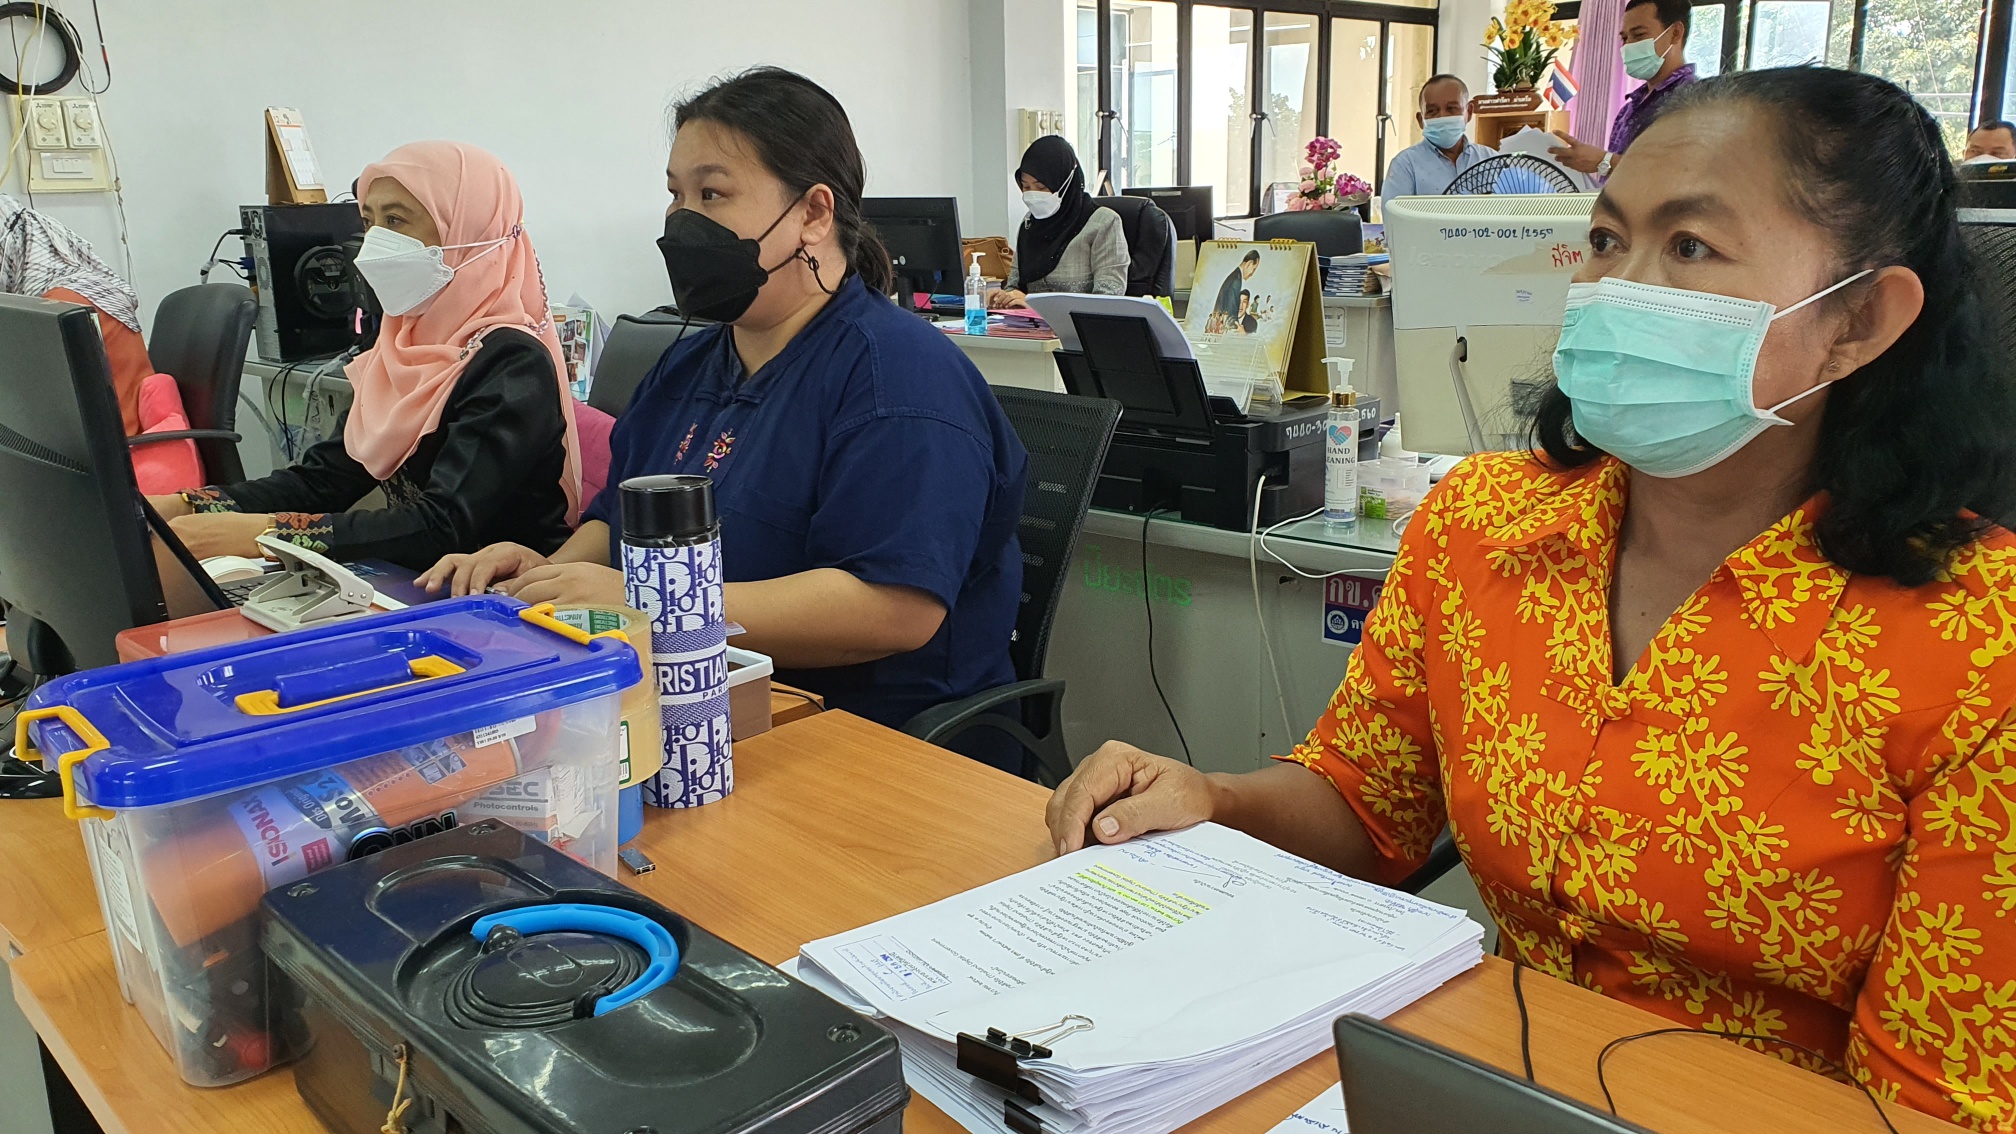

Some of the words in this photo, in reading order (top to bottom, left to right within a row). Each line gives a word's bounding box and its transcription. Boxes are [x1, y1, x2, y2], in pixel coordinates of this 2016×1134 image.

[1327, 447, 1351, 455] HAND
[1326, 457, 1355, 465] EANING
[473, 801, 539, 812] Photocontrols
